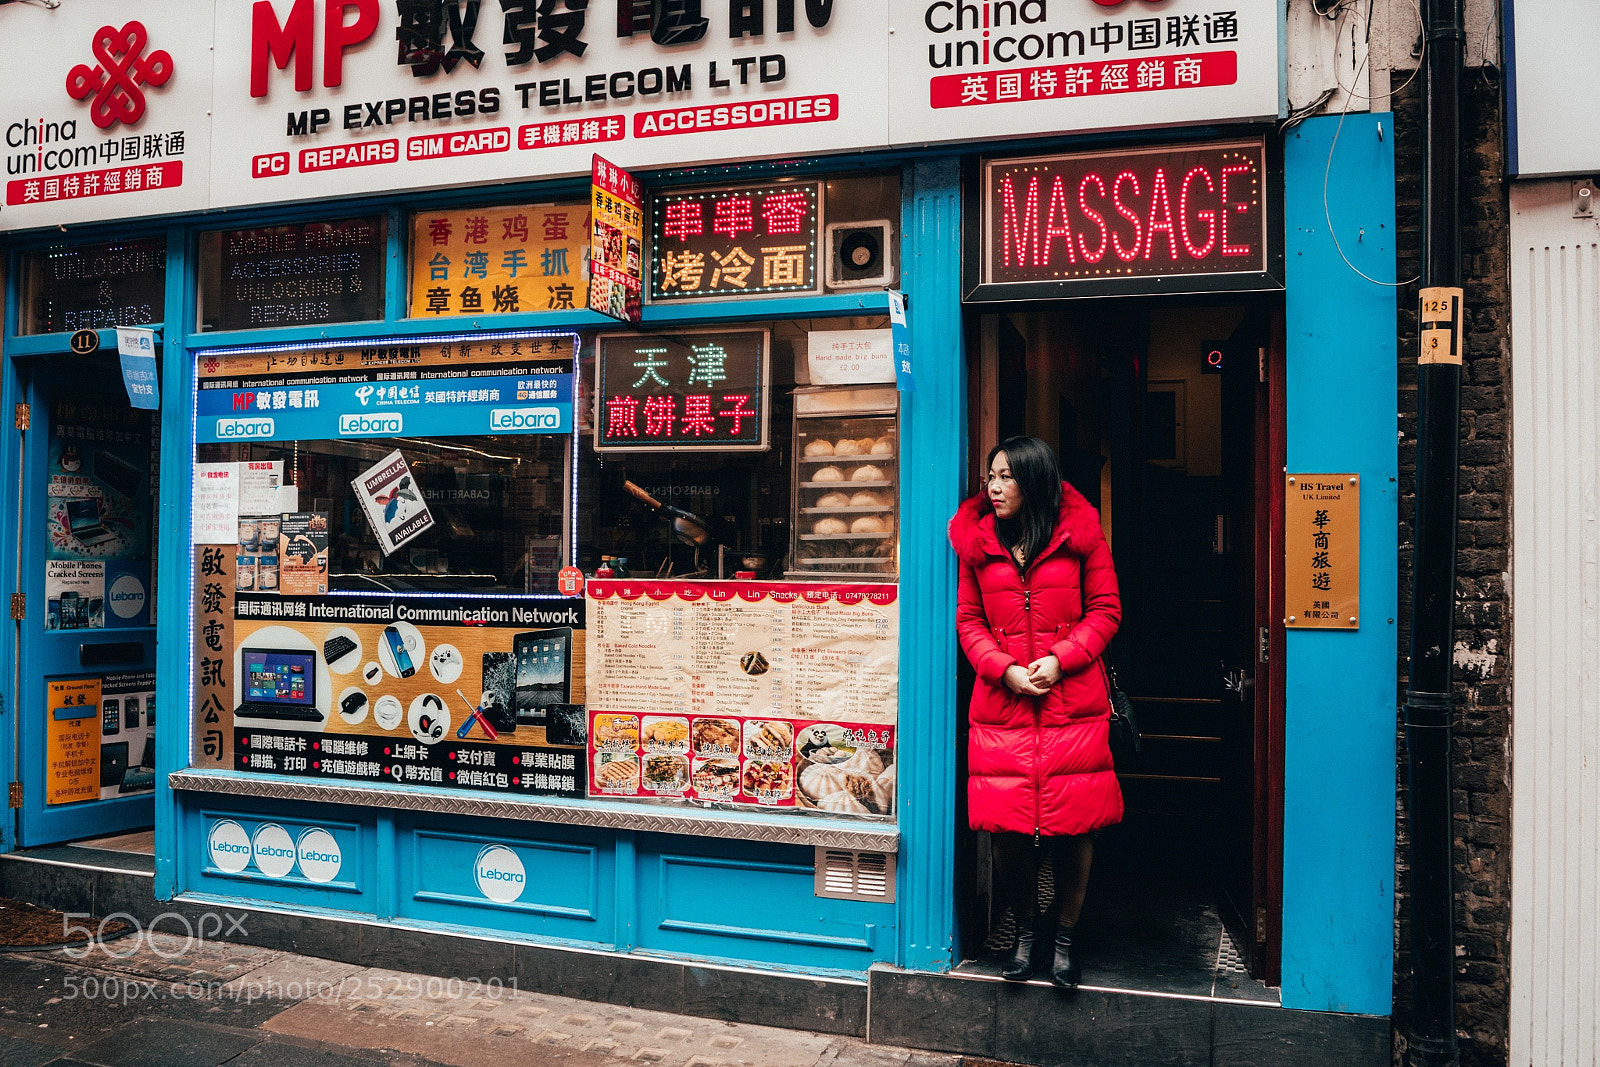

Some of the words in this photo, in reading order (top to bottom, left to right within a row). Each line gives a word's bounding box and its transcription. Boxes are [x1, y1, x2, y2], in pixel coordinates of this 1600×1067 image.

[925, 0, 1046, 33] China
[1089, 10, 1239, 54] 中国联通
[250, 0, 380, 98] MP
[928, 28, 1085, 69] unicom
[286, 107, 331, 136] MP
[344, 87, 501, 130] EXPRESS
[514, 64, 693, 110] TELECOM
[709, 53, 787, 90] LTD
[960, 57, 1203, 104] 英国特許經銷商
[641, 97, 832, 134] ACCESSORIES
[6, 117, 77, 148] China
[408, 134, 446, 158] SIM
[450, 127, 508, 152] CARD
[523, 119, 622, 147] 手機網絡卡
[7, 144, 97, 175] unicom
[99, 130, 186, 164] 中国联通
[303, 142, 396, 169] REPAIRS
[257, 155, 285, 174] PC
[23, 166, 164, 202] 英国特許經銷商
[595, 191, 640, 227] 香港鸡蛋仔
[664, 192, 808, 242] 串串香
[1003, 163, 1251, 267] MASSAGE
[230, 232, 296, 256] MOBILE
[305, 226, 371, 250] PHONE
[230, 252, 362, 280] ACCESSORIES
[428, 247, 590, 281] 台湾手抓
[660, 245, 808, 292] 烤冷面
[98, 280, 114, 305] &
[235, 274, 343, 302] UNLOCKING
[348, 273, 364, 294] &
[426, 284, 520, 315] 章鱼烧
[547, 283, 590, 310] 凉
[64, 303, 153, 332] REPAIRS
[250, 301, 330, 324] REPAIRS
[1424, 300, 1448, 312] 125
[77, 334, 91, 349] 11
[1431, 338, 1438, 349] 3
[632, 342, 727, 389] 天津
[815, 354, 832, 362] Hand
[834, 353, 853, 362] made
[855, 352, 869, 363] big
[870, 352, 888, 361] buns
[242, 378, 285, 388] International
[286, 376, 337, 386] communication
[338, 374, 369, 383] network
[420, 370, 469, 380] International
[471, 366, 528, 378] communication
[530, 366, 564, 375] network
[232, 392, 256, 411] MP
[218, 420, 272, 438] Lebara
[340, 414, 400, 434] Lebara
[492, 409, 558, 429] Lebara
[606, 394, 755, 438] 煎饼果子
[366, 460, 406, 490] UMBRELLAS
[1300, 483, 1314, 491] HS
[1315, 483, 1344, 491] Travel
[394, 514, 429, 543] AVAILABLE
[1311, 509, 1332, 592] 華商旅遊
[110, 592, 144, 602] Lebara
[713, 590, 726, 598] Lin
[748, 590, 760, 598] Lin
[770, 590, 798, 600] Snacks
[237, 600, 306, 619] 国际通讯网络
[308, 604, 394, 621] International
[396, 605, 510, 623] Communication
[512, 608, 579, 625] Network
[1304, 610, 1338, 620] 有限公司
[250, 734, 307, 752] 國際電話卡
[320, 738, 369, 757] 電腦維修
[391, 743, 430, 761] 上網卡
[456, 749, 496, 767] 支付寶
[456, 771, 509, 789] 微信紅包
[520, 774, 576, 792] 手機解鎖
[212, 840, 250, 856] Lebara
[256, 844, 294, 858] Lebara
[300, 848, 340, 864] Lebara
[480, 866, 524, 884] Lebara
